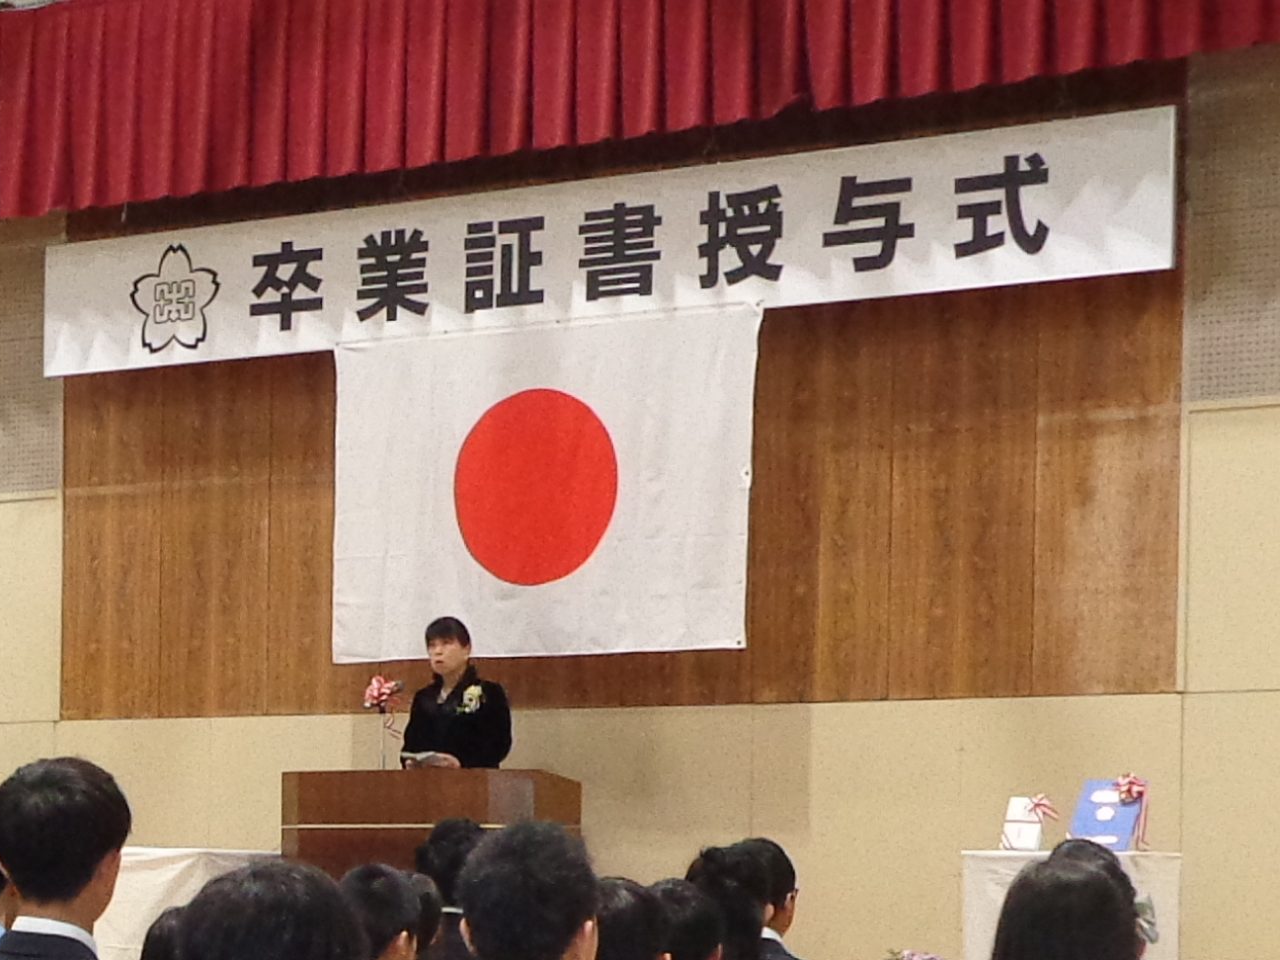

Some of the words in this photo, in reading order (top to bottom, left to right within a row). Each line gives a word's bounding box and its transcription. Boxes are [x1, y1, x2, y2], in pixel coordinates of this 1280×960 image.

[249, 153, 1048, 332] 卒業証書授与式
